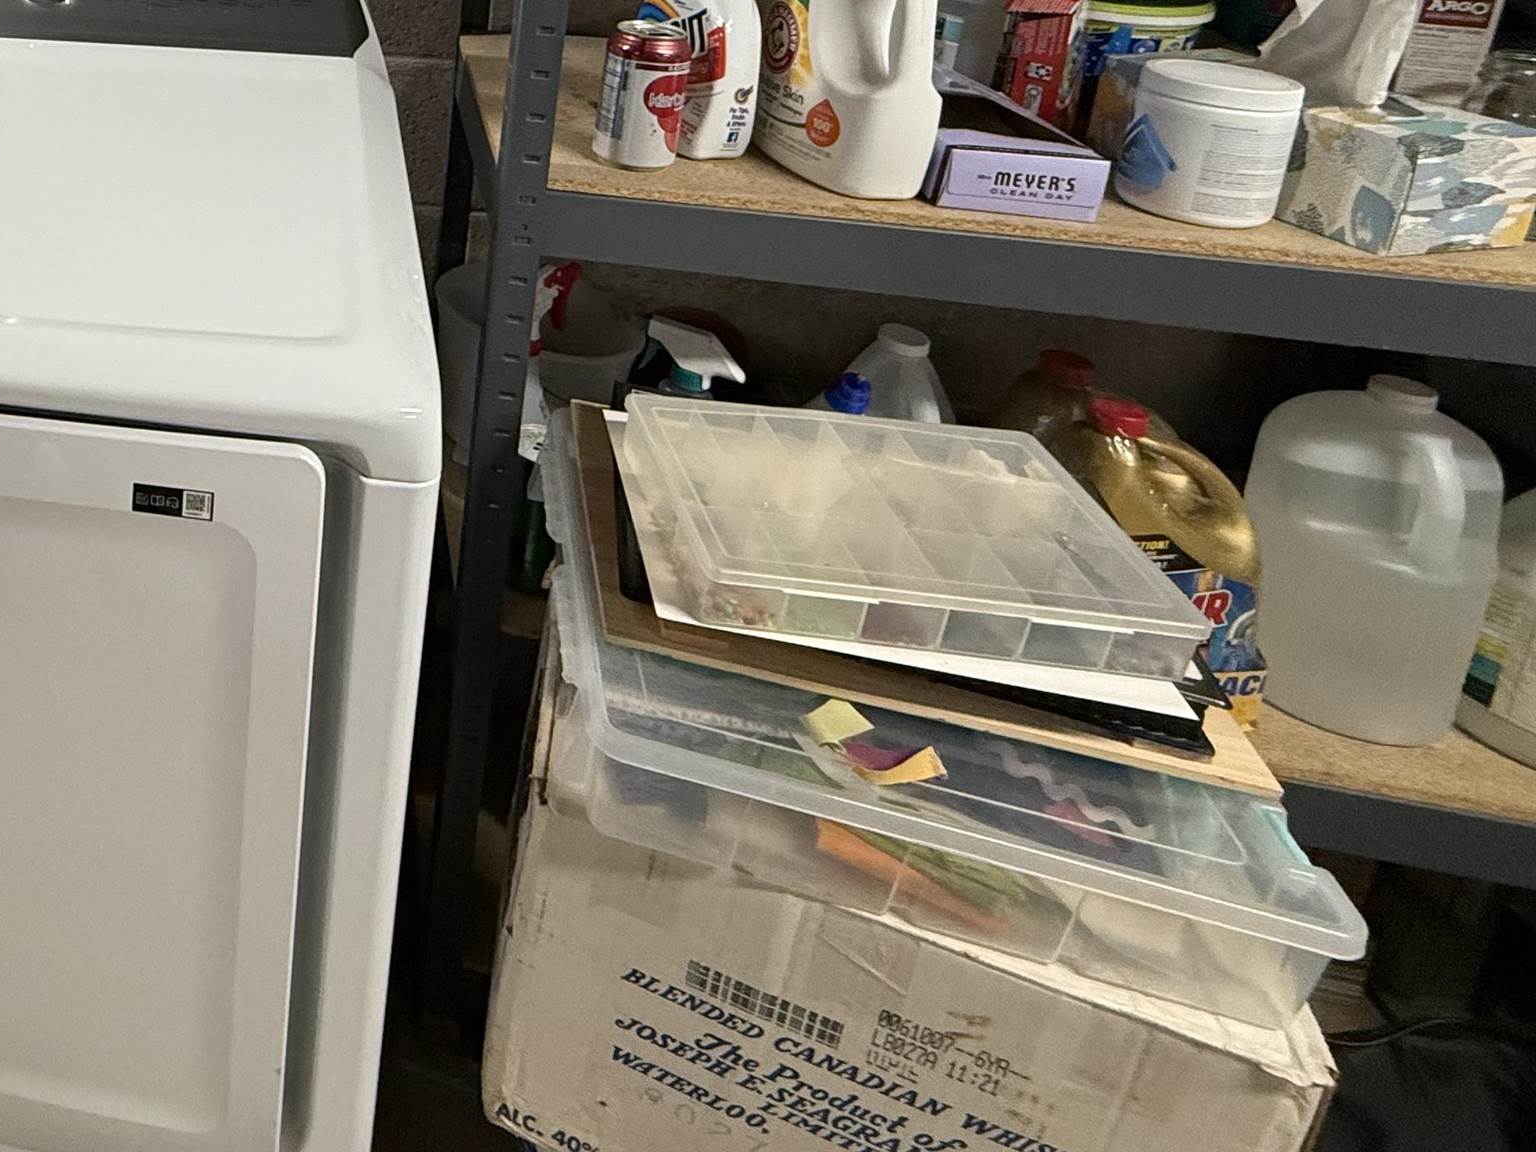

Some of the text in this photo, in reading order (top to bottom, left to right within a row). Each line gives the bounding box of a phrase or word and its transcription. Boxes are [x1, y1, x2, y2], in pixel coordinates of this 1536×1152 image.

[1428, 0, 1491, 16] ARGO
[990, 187, 1075, 202] CLEAN DAY
[994, 171, 1076, 192] MEYER'S
[621, 967, 765, 1039] BLENDED
[773, 1036, 953, 1116] CANADIAN
[614, 1017, 737, 1079] JOSEPH
[735, 1073, 766, 1096] E.
[766, 1087, 922, 1152] SEAGRA
[694, 1032, 760, 1072] The
[762, 1061, 910, 1134] Product
[945, 1061, 1001, 1097] 11:21
[757, 1102, 874, 1152] LIMIT
